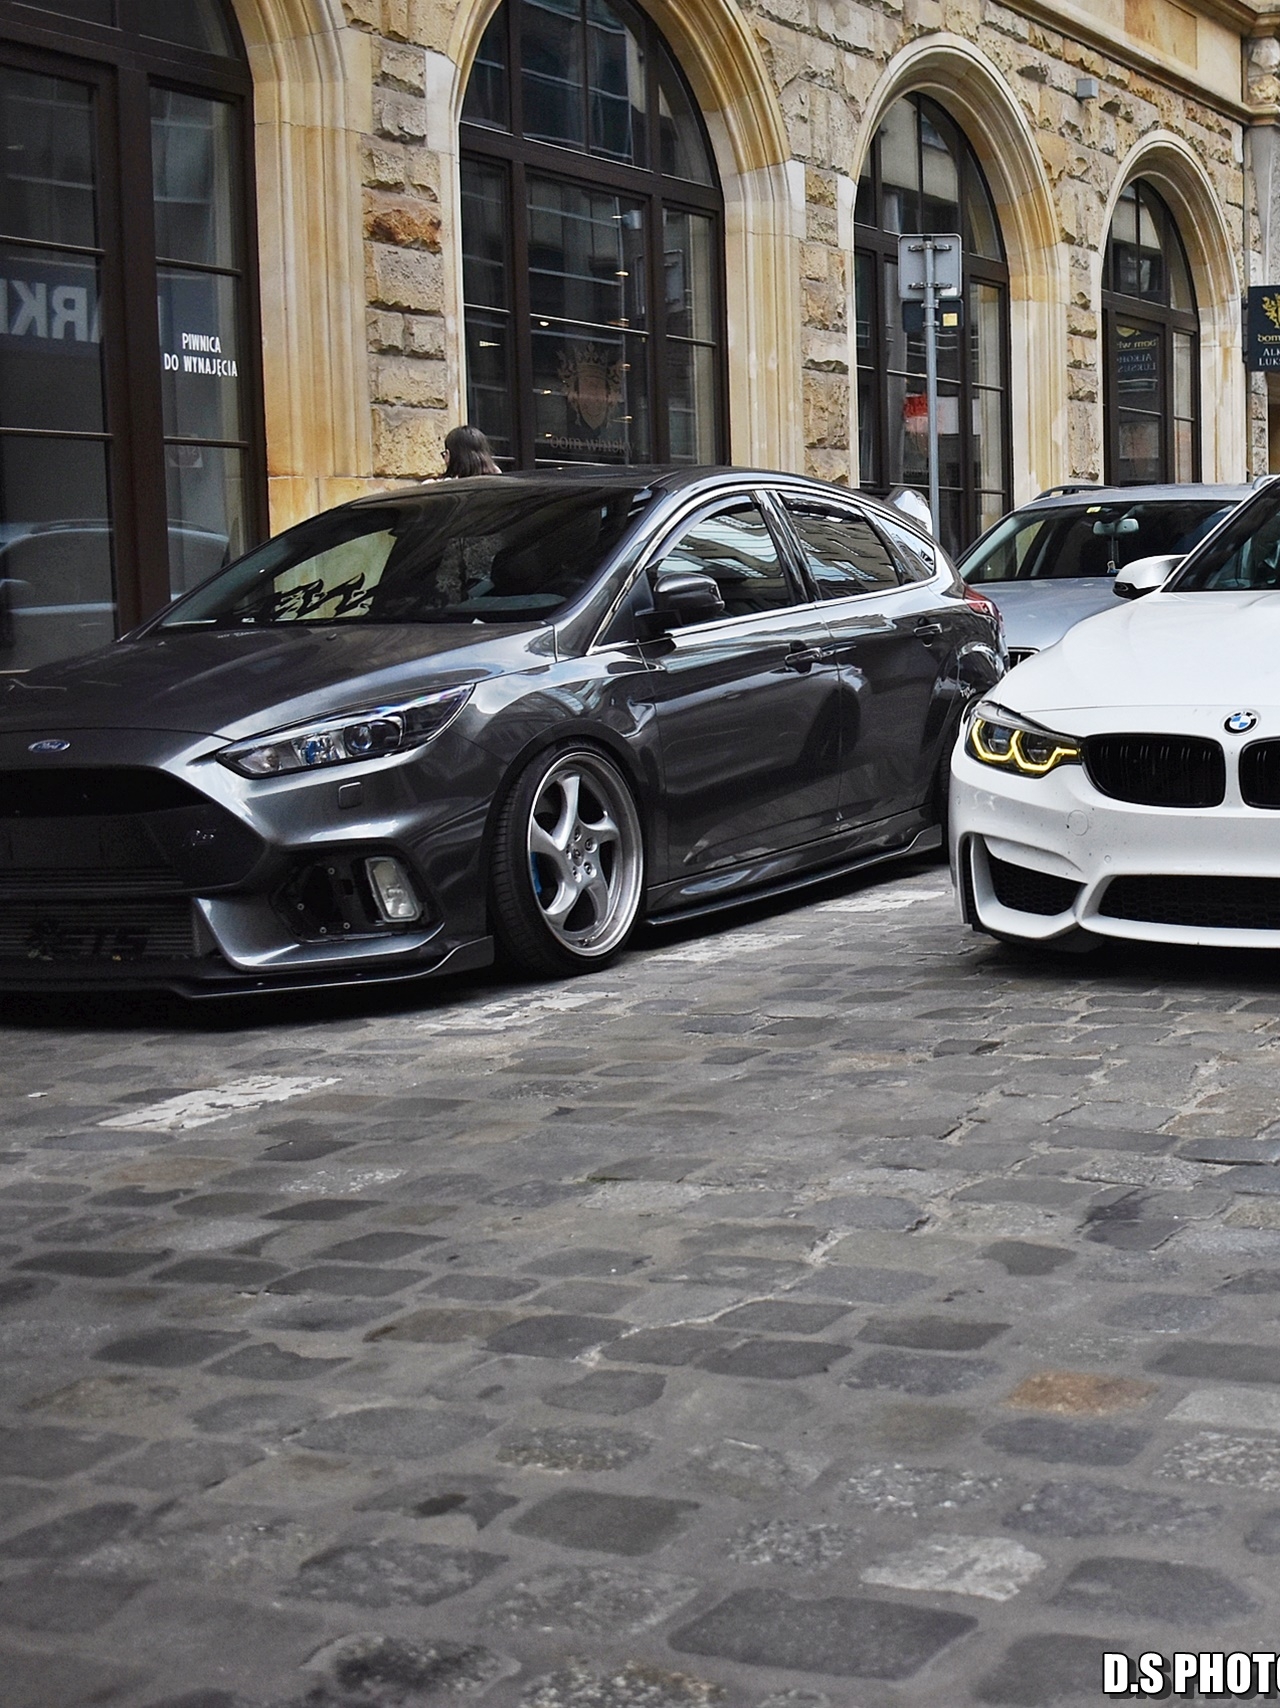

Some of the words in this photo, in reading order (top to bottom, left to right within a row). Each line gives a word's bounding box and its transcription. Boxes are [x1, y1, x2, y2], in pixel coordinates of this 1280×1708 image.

[182, 333, 221, 353] PIWNICA
[164, 353, 179, 371] DO
[184, 355, 238, 377] WYNAJĘCIA
